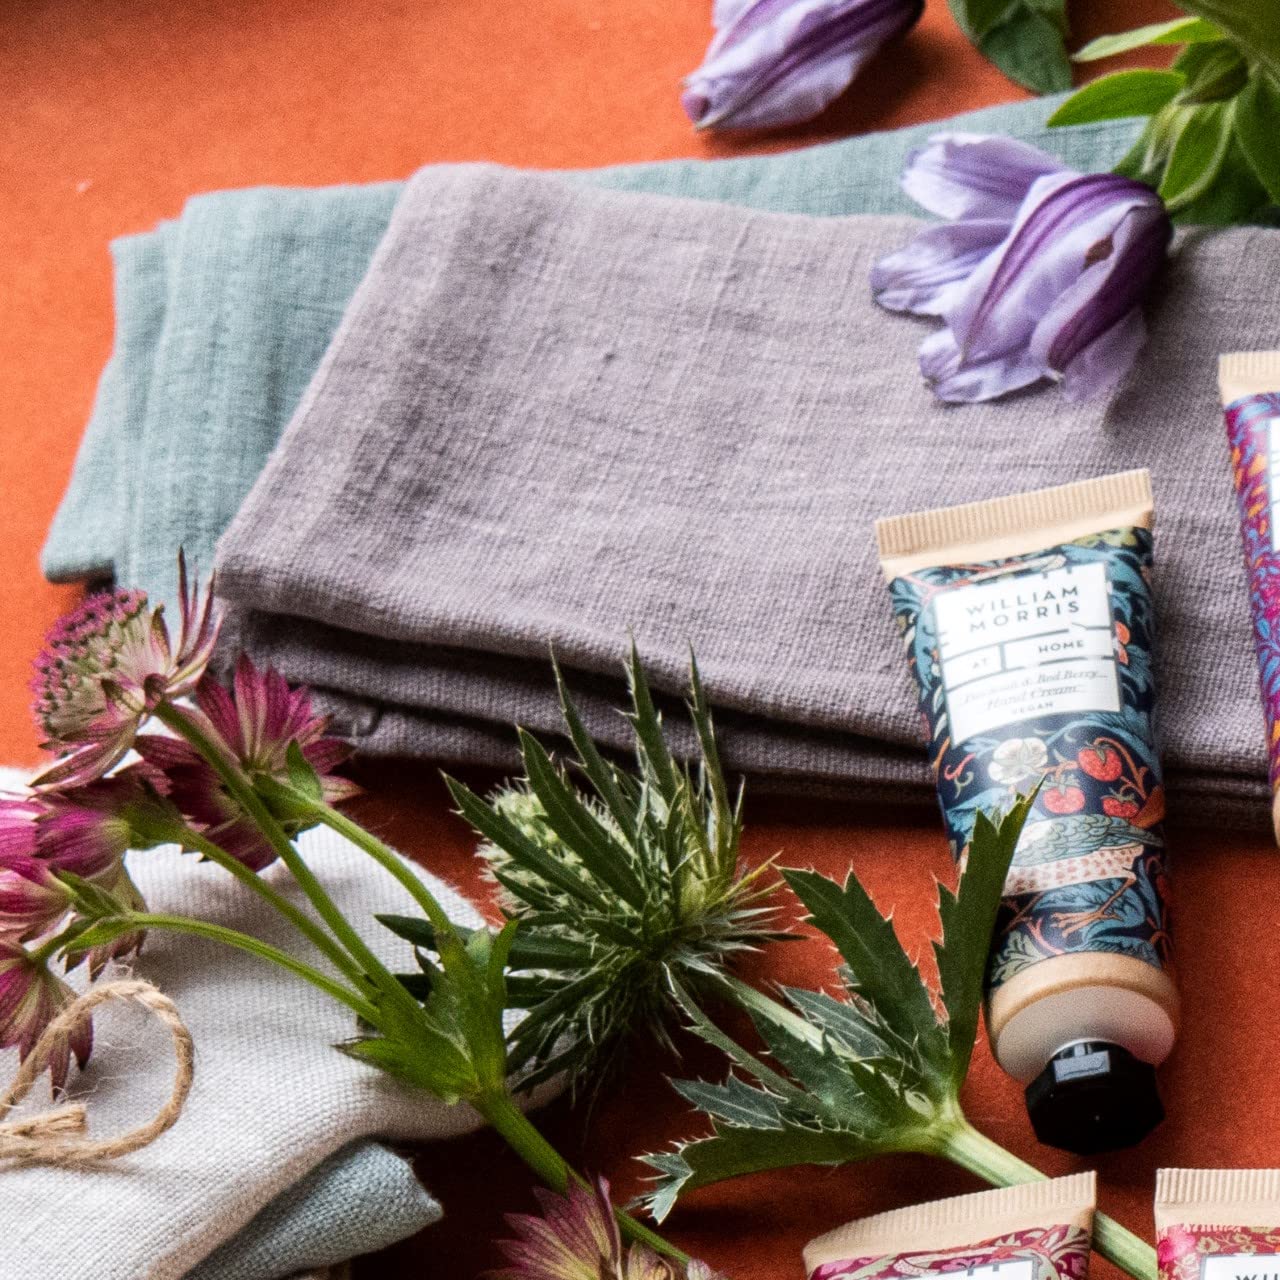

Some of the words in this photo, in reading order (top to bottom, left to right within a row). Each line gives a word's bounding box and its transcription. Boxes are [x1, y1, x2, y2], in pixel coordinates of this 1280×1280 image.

[967, 586, 1079, 615] WILLIAM
[969, 601, 1079, 632] MORRIS
[972, 658, 988, 670] AT
[1038, 640, 1084, 654] HOME
